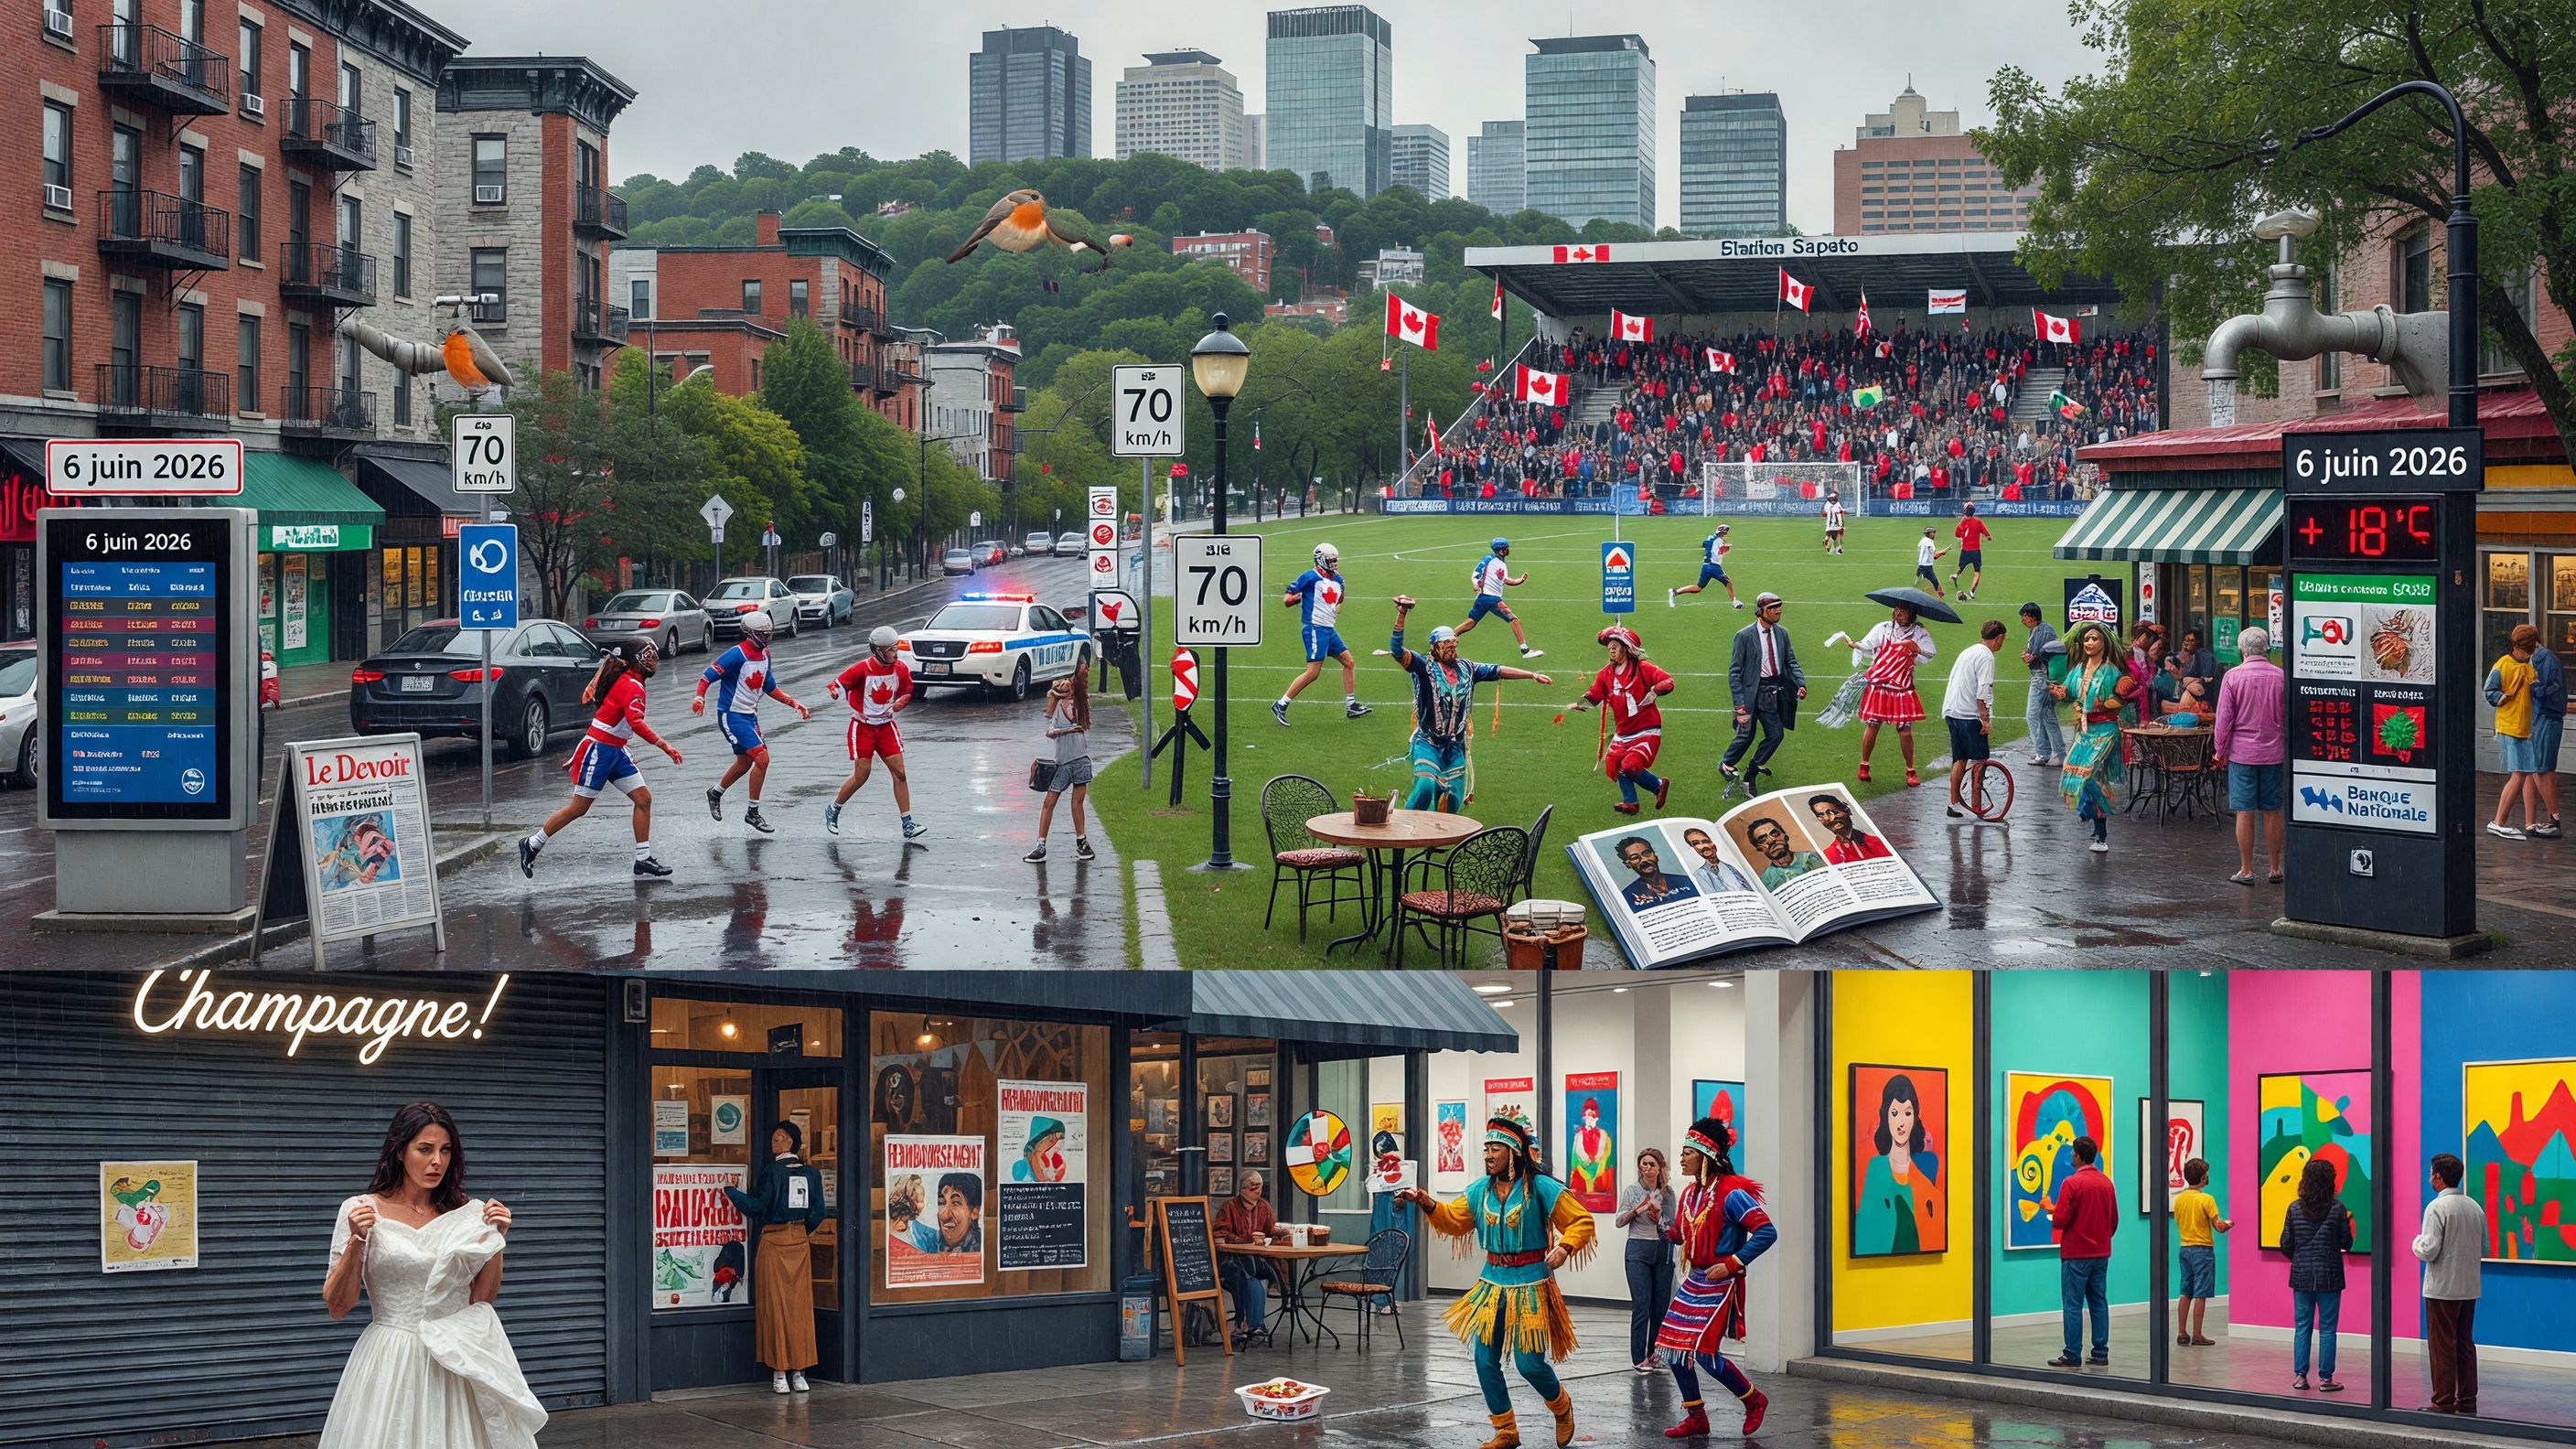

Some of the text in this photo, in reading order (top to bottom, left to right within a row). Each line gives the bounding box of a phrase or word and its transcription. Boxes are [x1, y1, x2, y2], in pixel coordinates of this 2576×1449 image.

[1123, 388, 1173, 423] 70
[462, 435, 505, 466] 70
[1125, 429, 1171, 447] km/h
[63, 453, 225, 487] 6 juin 2026
[464, 469, 505, 485] km/h
[2296, 445, 2467, 485] 6 juin 2026
[86, 532, 191, 554] 6 juin 2026
[1188, 565, 1248, 606] 70
[1189, 614, 1246, 637] km/h
[306, 752, 411, 786] Le Devoir
[133, 970, 510, 1066] Champagne!
